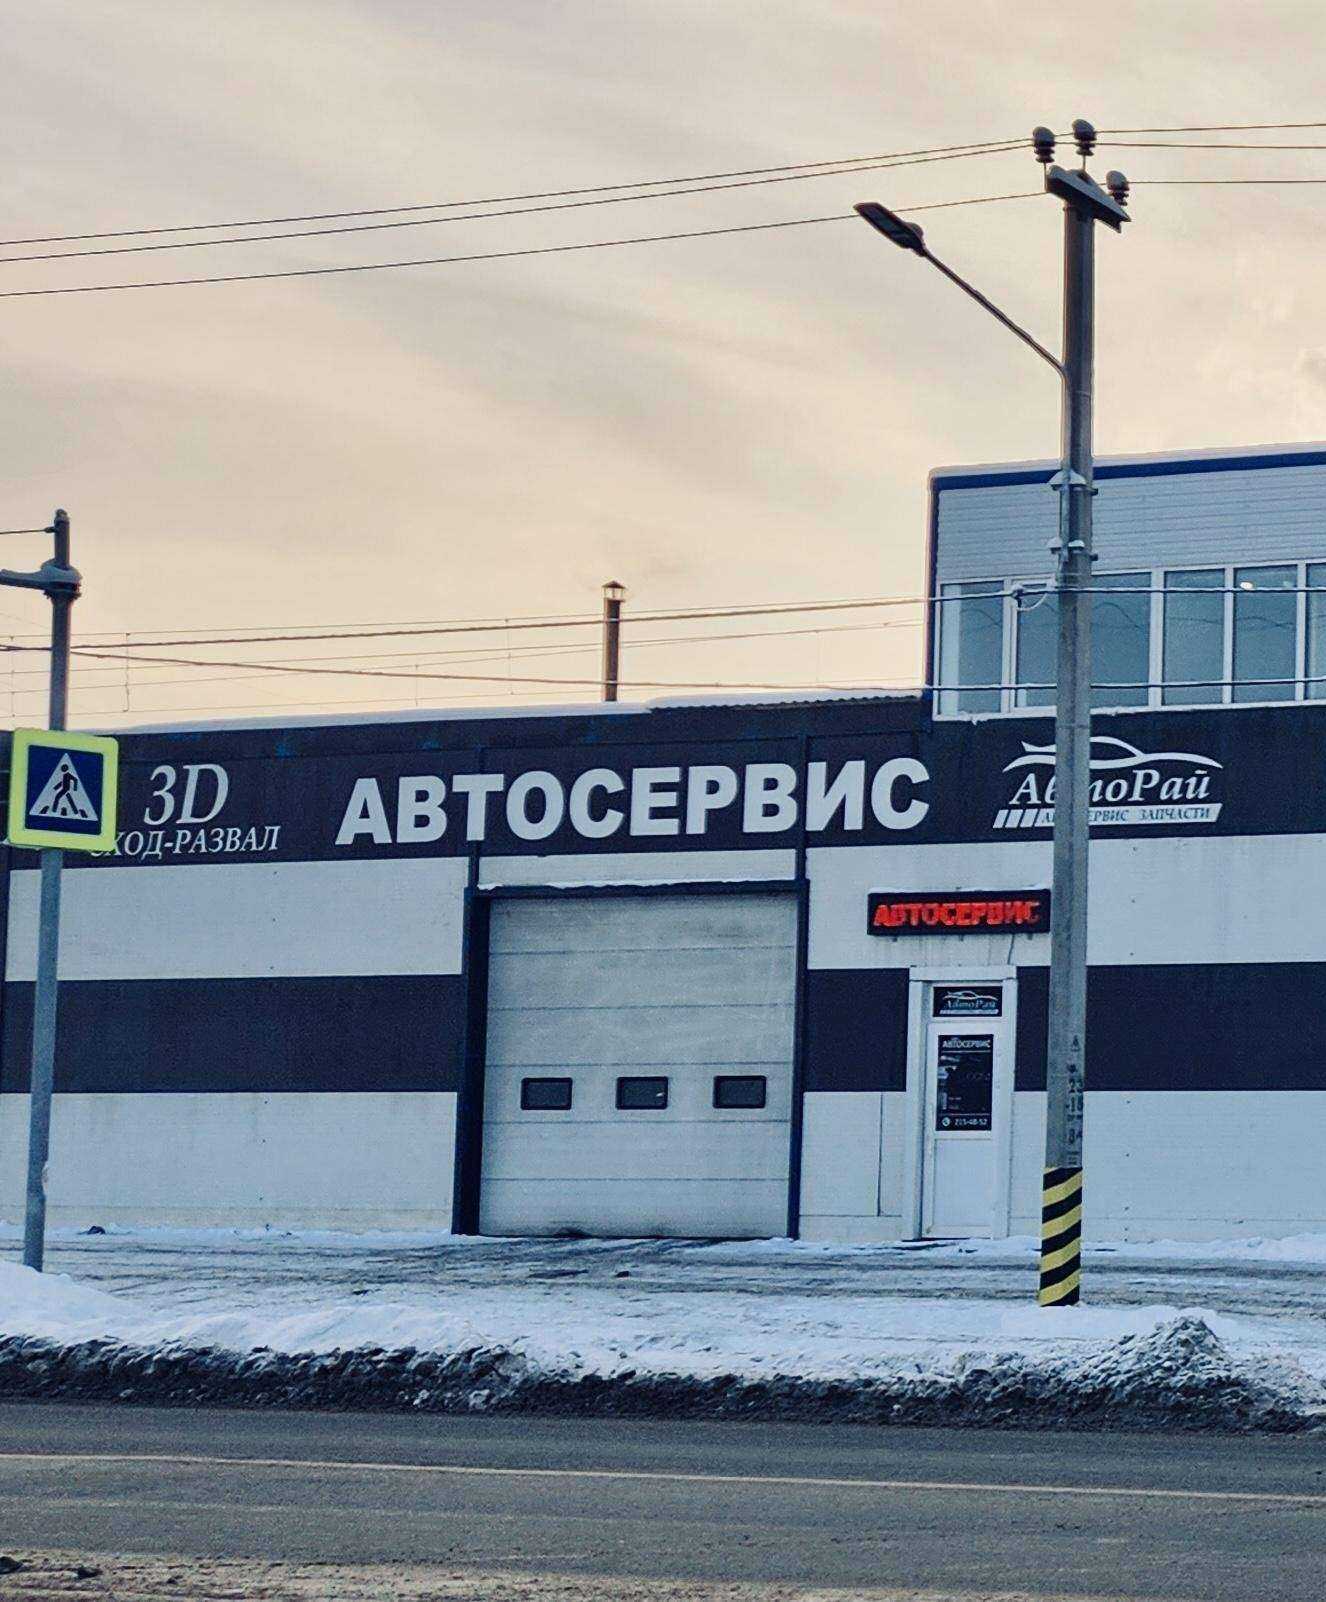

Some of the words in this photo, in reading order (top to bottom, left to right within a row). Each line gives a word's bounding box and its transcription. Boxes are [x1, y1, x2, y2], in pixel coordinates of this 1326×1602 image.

[143, 763, 229, 826] 3D
[335, 757, 931, 846] АВТОСЕРВИС
[1140, 807, 1210, 821] ЗАПЧАСТИ
[91, 825, 281, 860] ХОД-РАЗВАЛ
[873, 901, 1040, 926] АВТОСЕРВИС
